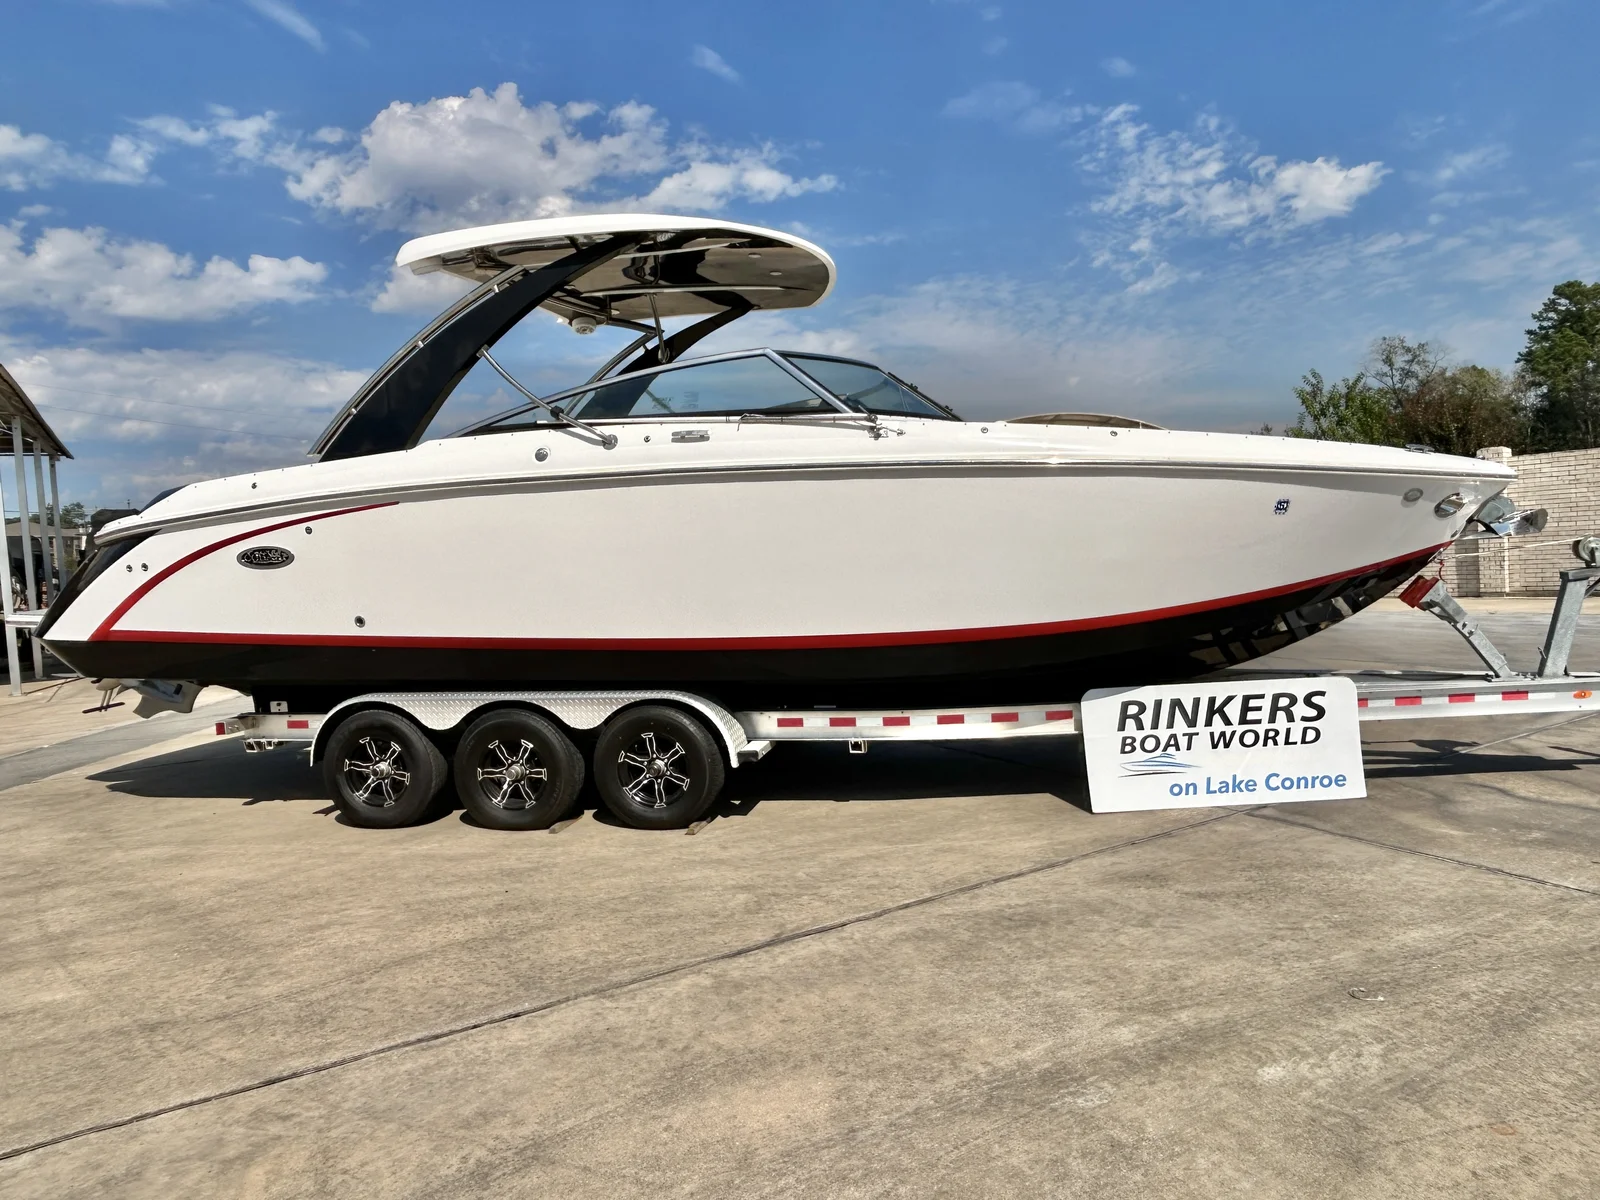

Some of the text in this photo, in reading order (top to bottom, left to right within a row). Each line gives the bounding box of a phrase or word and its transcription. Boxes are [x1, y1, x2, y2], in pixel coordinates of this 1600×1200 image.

[1116, 690, 1327, 732] RINKERS
[1119, 726, 1322, 755] BOAT WORLD
[1169, 772, 1347, 797] on Lake Conroe
